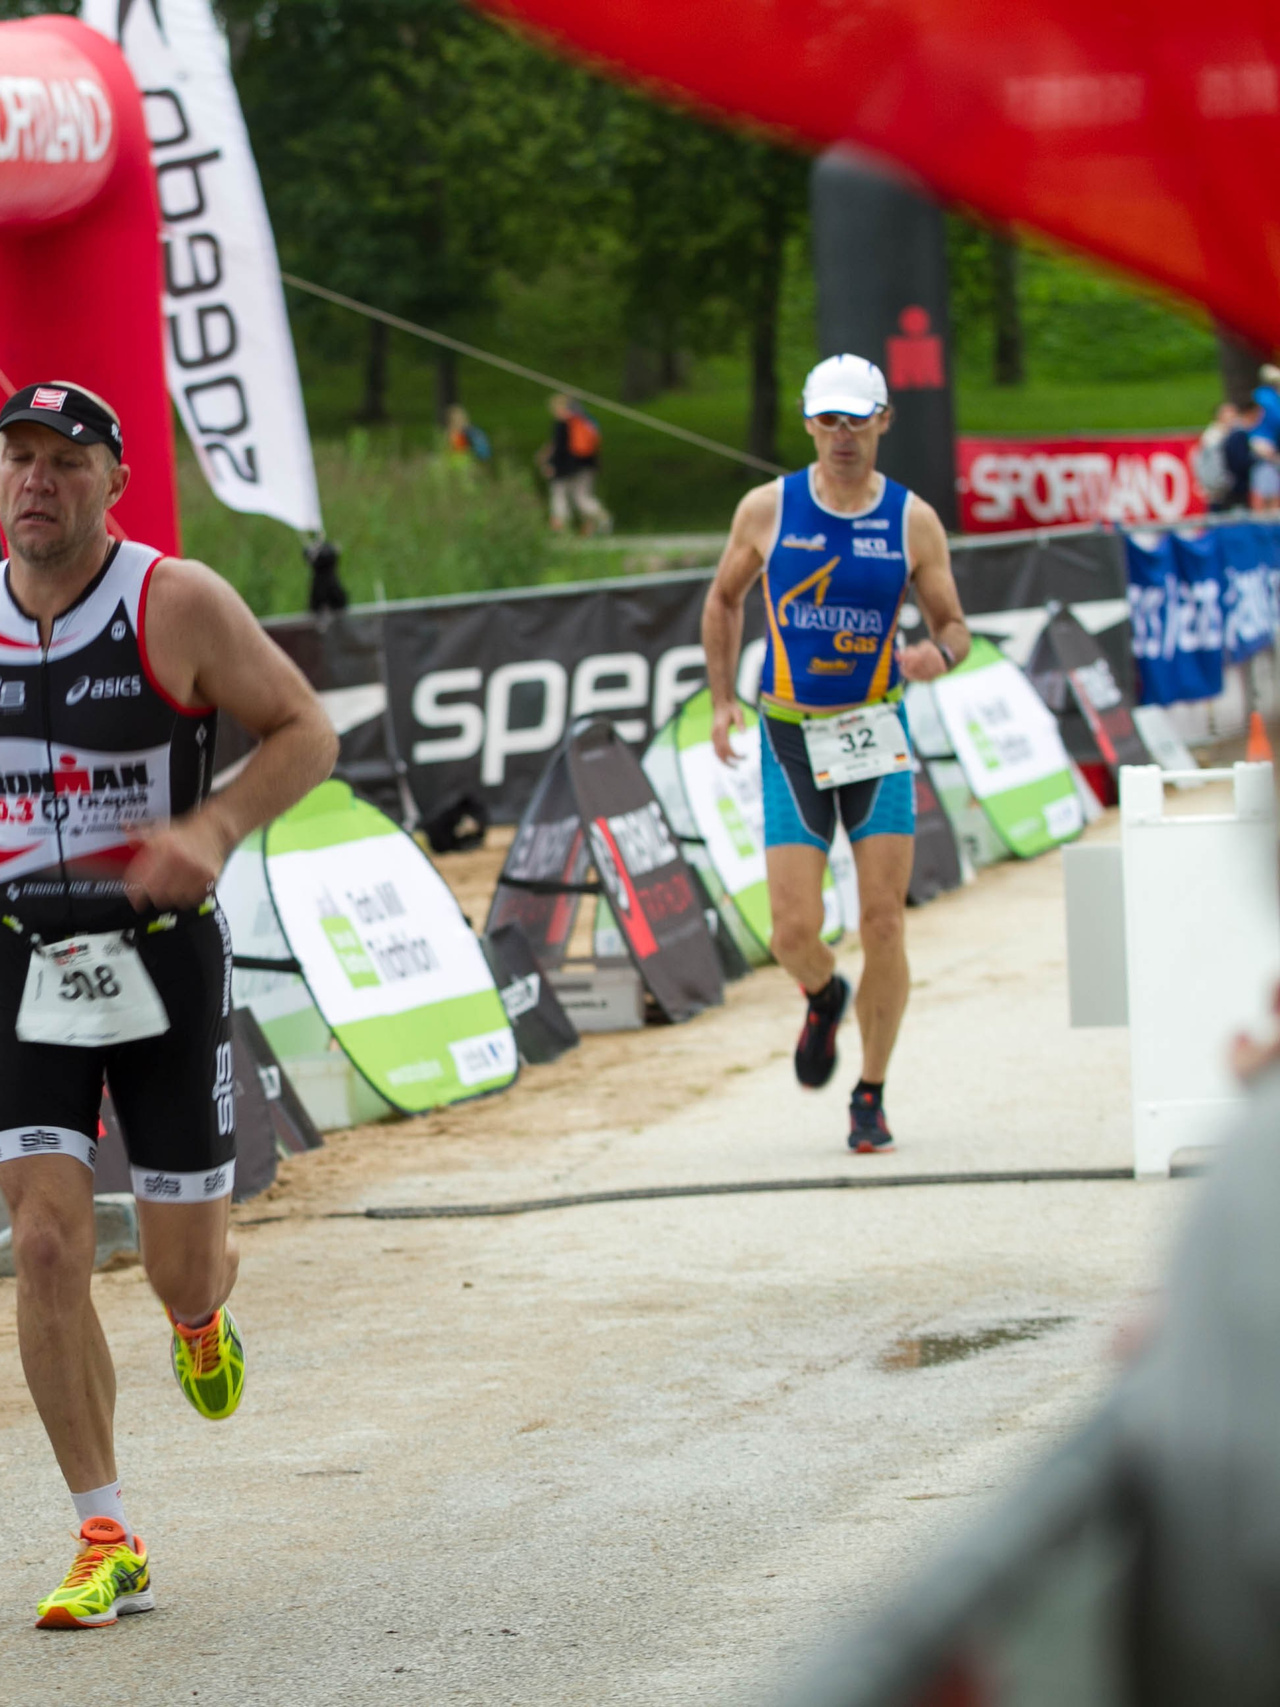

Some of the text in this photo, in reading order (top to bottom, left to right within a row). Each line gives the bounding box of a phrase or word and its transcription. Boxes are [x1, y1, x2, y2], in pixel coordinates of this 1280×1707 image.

[790, 602, 883, 633] TAUNA
[833, 631, 878, 654] Gas
[839, 728, 877, 753] 32
